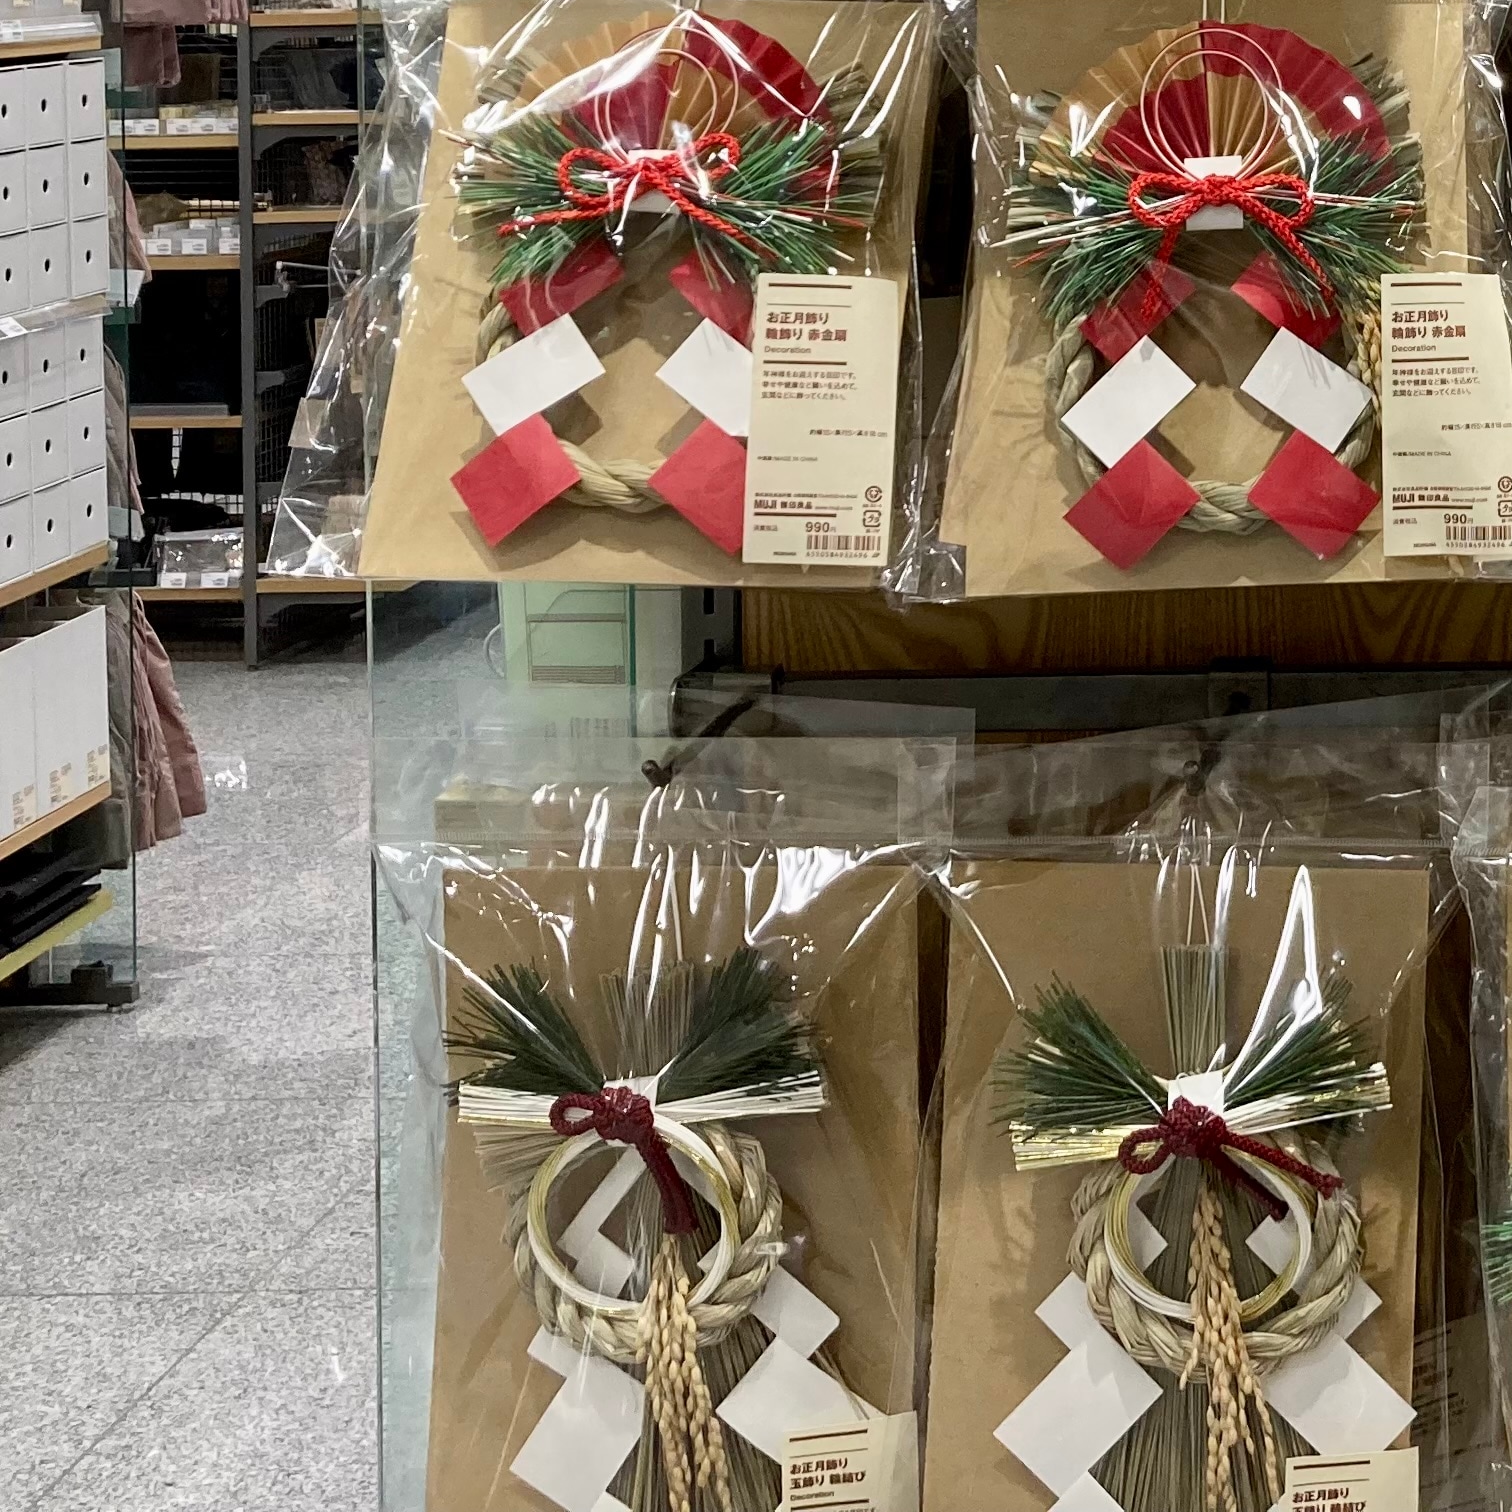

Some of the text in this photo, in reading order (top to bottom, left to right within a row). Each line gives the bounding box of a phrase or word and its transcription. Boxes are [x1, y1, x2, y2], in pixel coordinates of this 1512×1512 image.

[767, 312, 829, 324] お正月飾り
[1391, 310, 1449, 323] お正月飾り
[764, 346, 811, 354] Decoration
[1391, 345, 1436, 353] Decoration
[1392, 494, 1415, 503] MUJI
[754, 499, 777, 510] MUJI
[1292, 1487, 1349, 1503] お正月飾り
